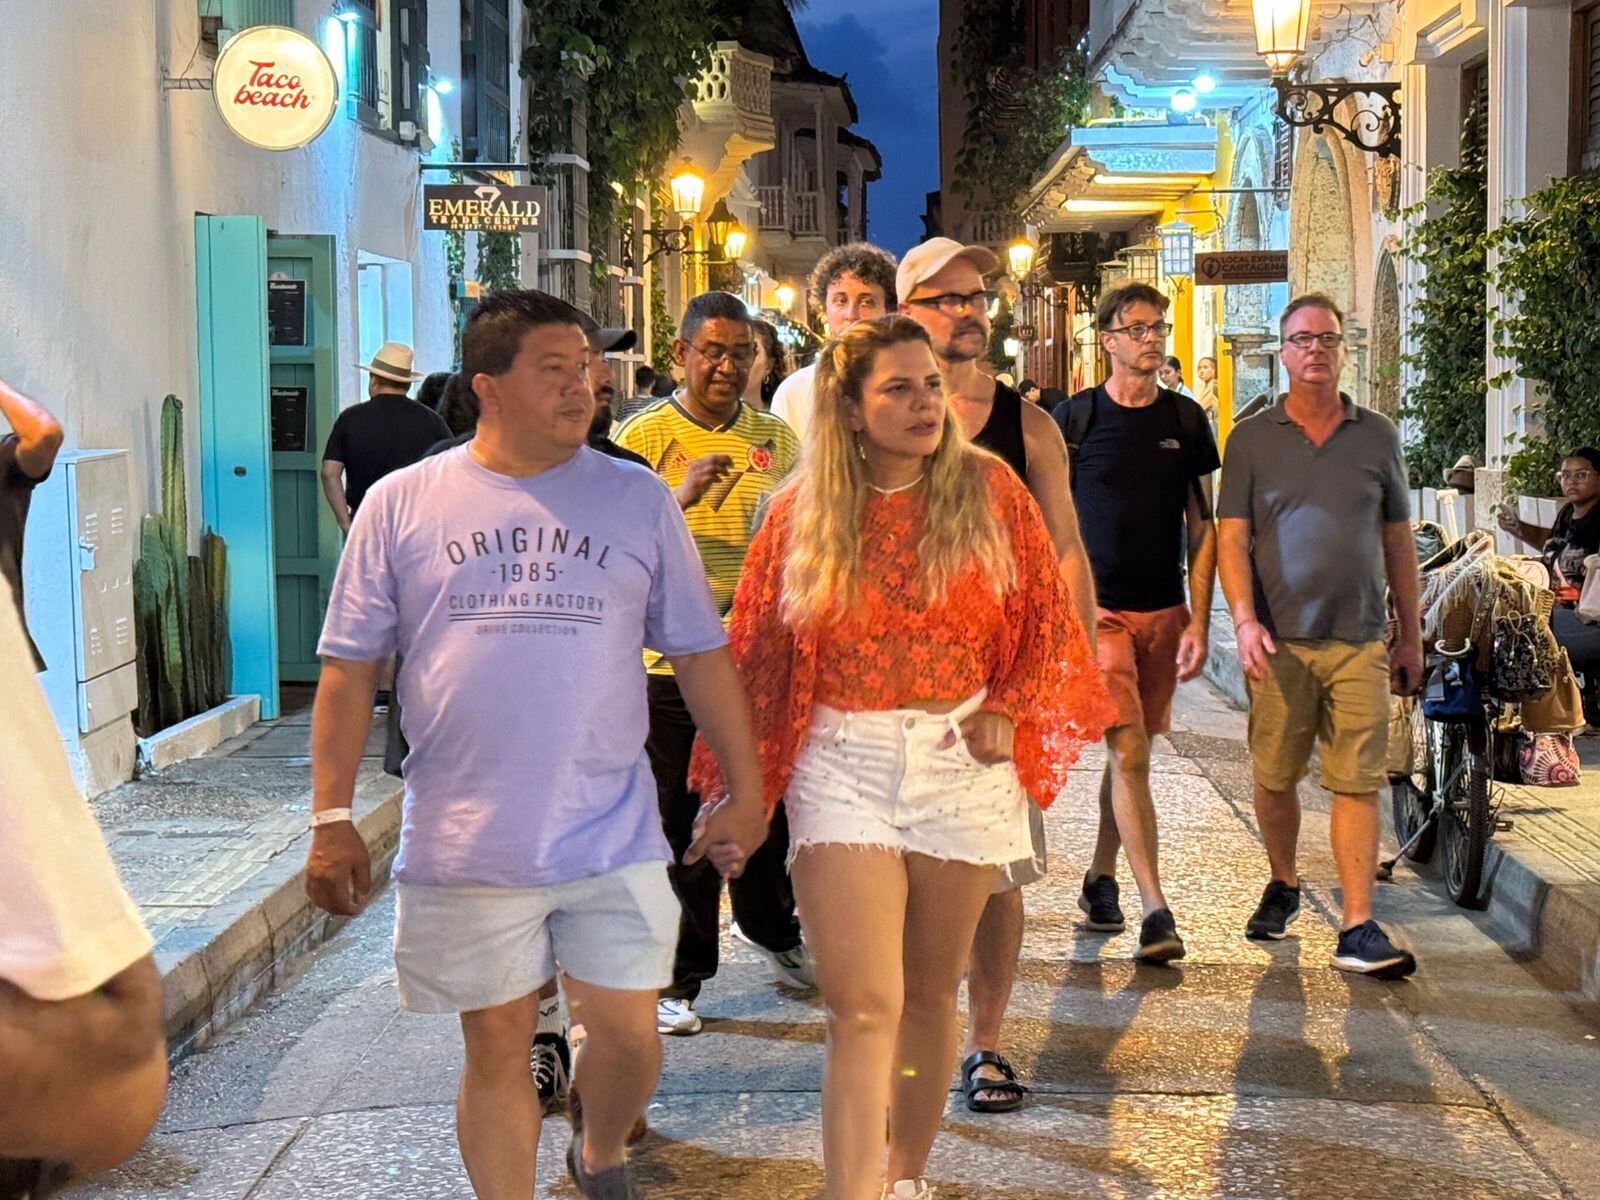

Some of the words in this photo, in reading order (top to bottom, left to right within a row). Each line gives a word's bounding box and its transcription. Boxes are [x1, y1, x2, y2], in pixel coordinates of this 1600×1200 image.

[248, 60, 301, 90] Taco
[233, 84, 311, 109] beach
[428, 199, 541, 217] EMERALD
[431, 216, 479, 224] TRADE
[484, 216, 539, 226] CENTER
[1221, 262, 1286, 272] CARTAGENA
[446, 527, 610, 570] ORIGINAL
[448, 592, 530, 610] CLOTHING
[535, 593, 604, 612] FACTORY
